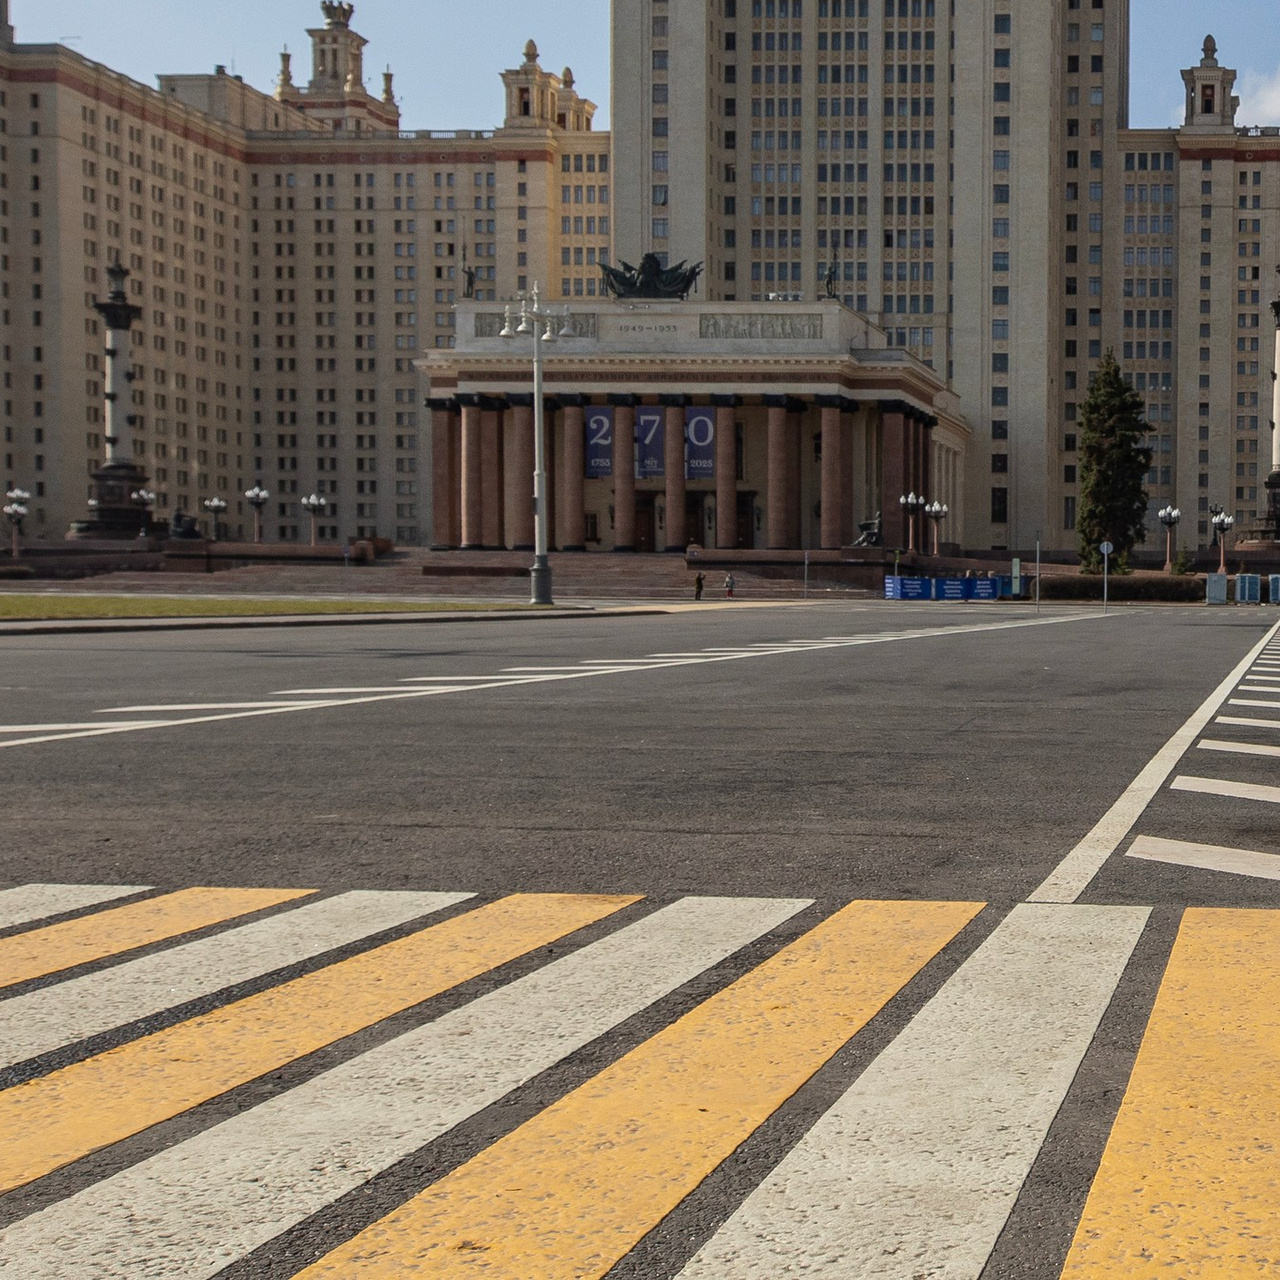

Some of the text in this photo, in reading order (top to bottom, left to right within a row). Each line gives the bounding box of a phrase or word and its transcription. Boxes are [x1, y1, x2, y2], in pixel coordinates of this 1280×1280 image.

[589, 415, 611, 445] 2
[640, 415, 660, 445] 7
[688, 416, 714, 446] 0
[591, 458, 611, 467] 1755
[690, 459, 713, 468] 2025
